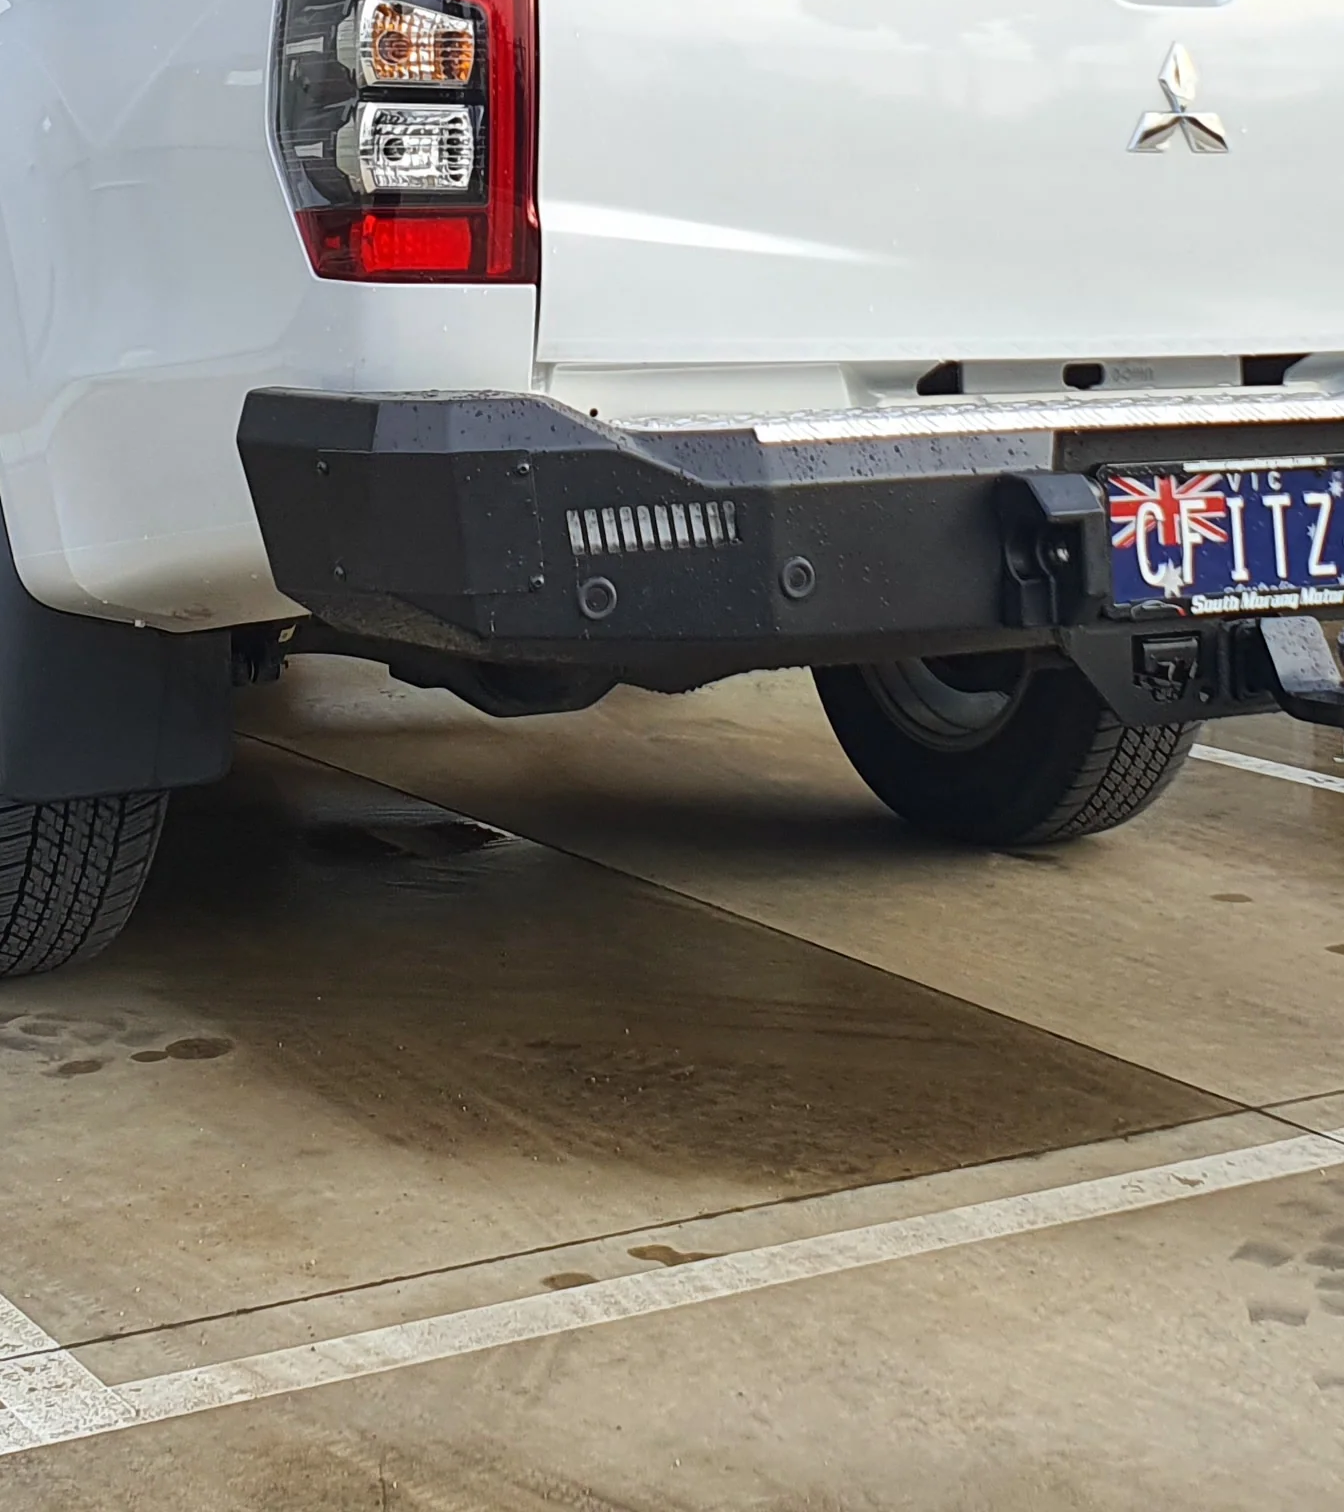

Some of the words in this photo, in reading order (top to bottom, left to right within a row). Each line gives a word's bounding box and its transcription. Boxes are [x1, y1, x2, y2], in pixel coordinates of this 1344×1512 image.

[1226, 470, 1284, 492] VIC
[1135, 492, 1338, 588] CFITZ
[1190, 594, 1240, 615] South
